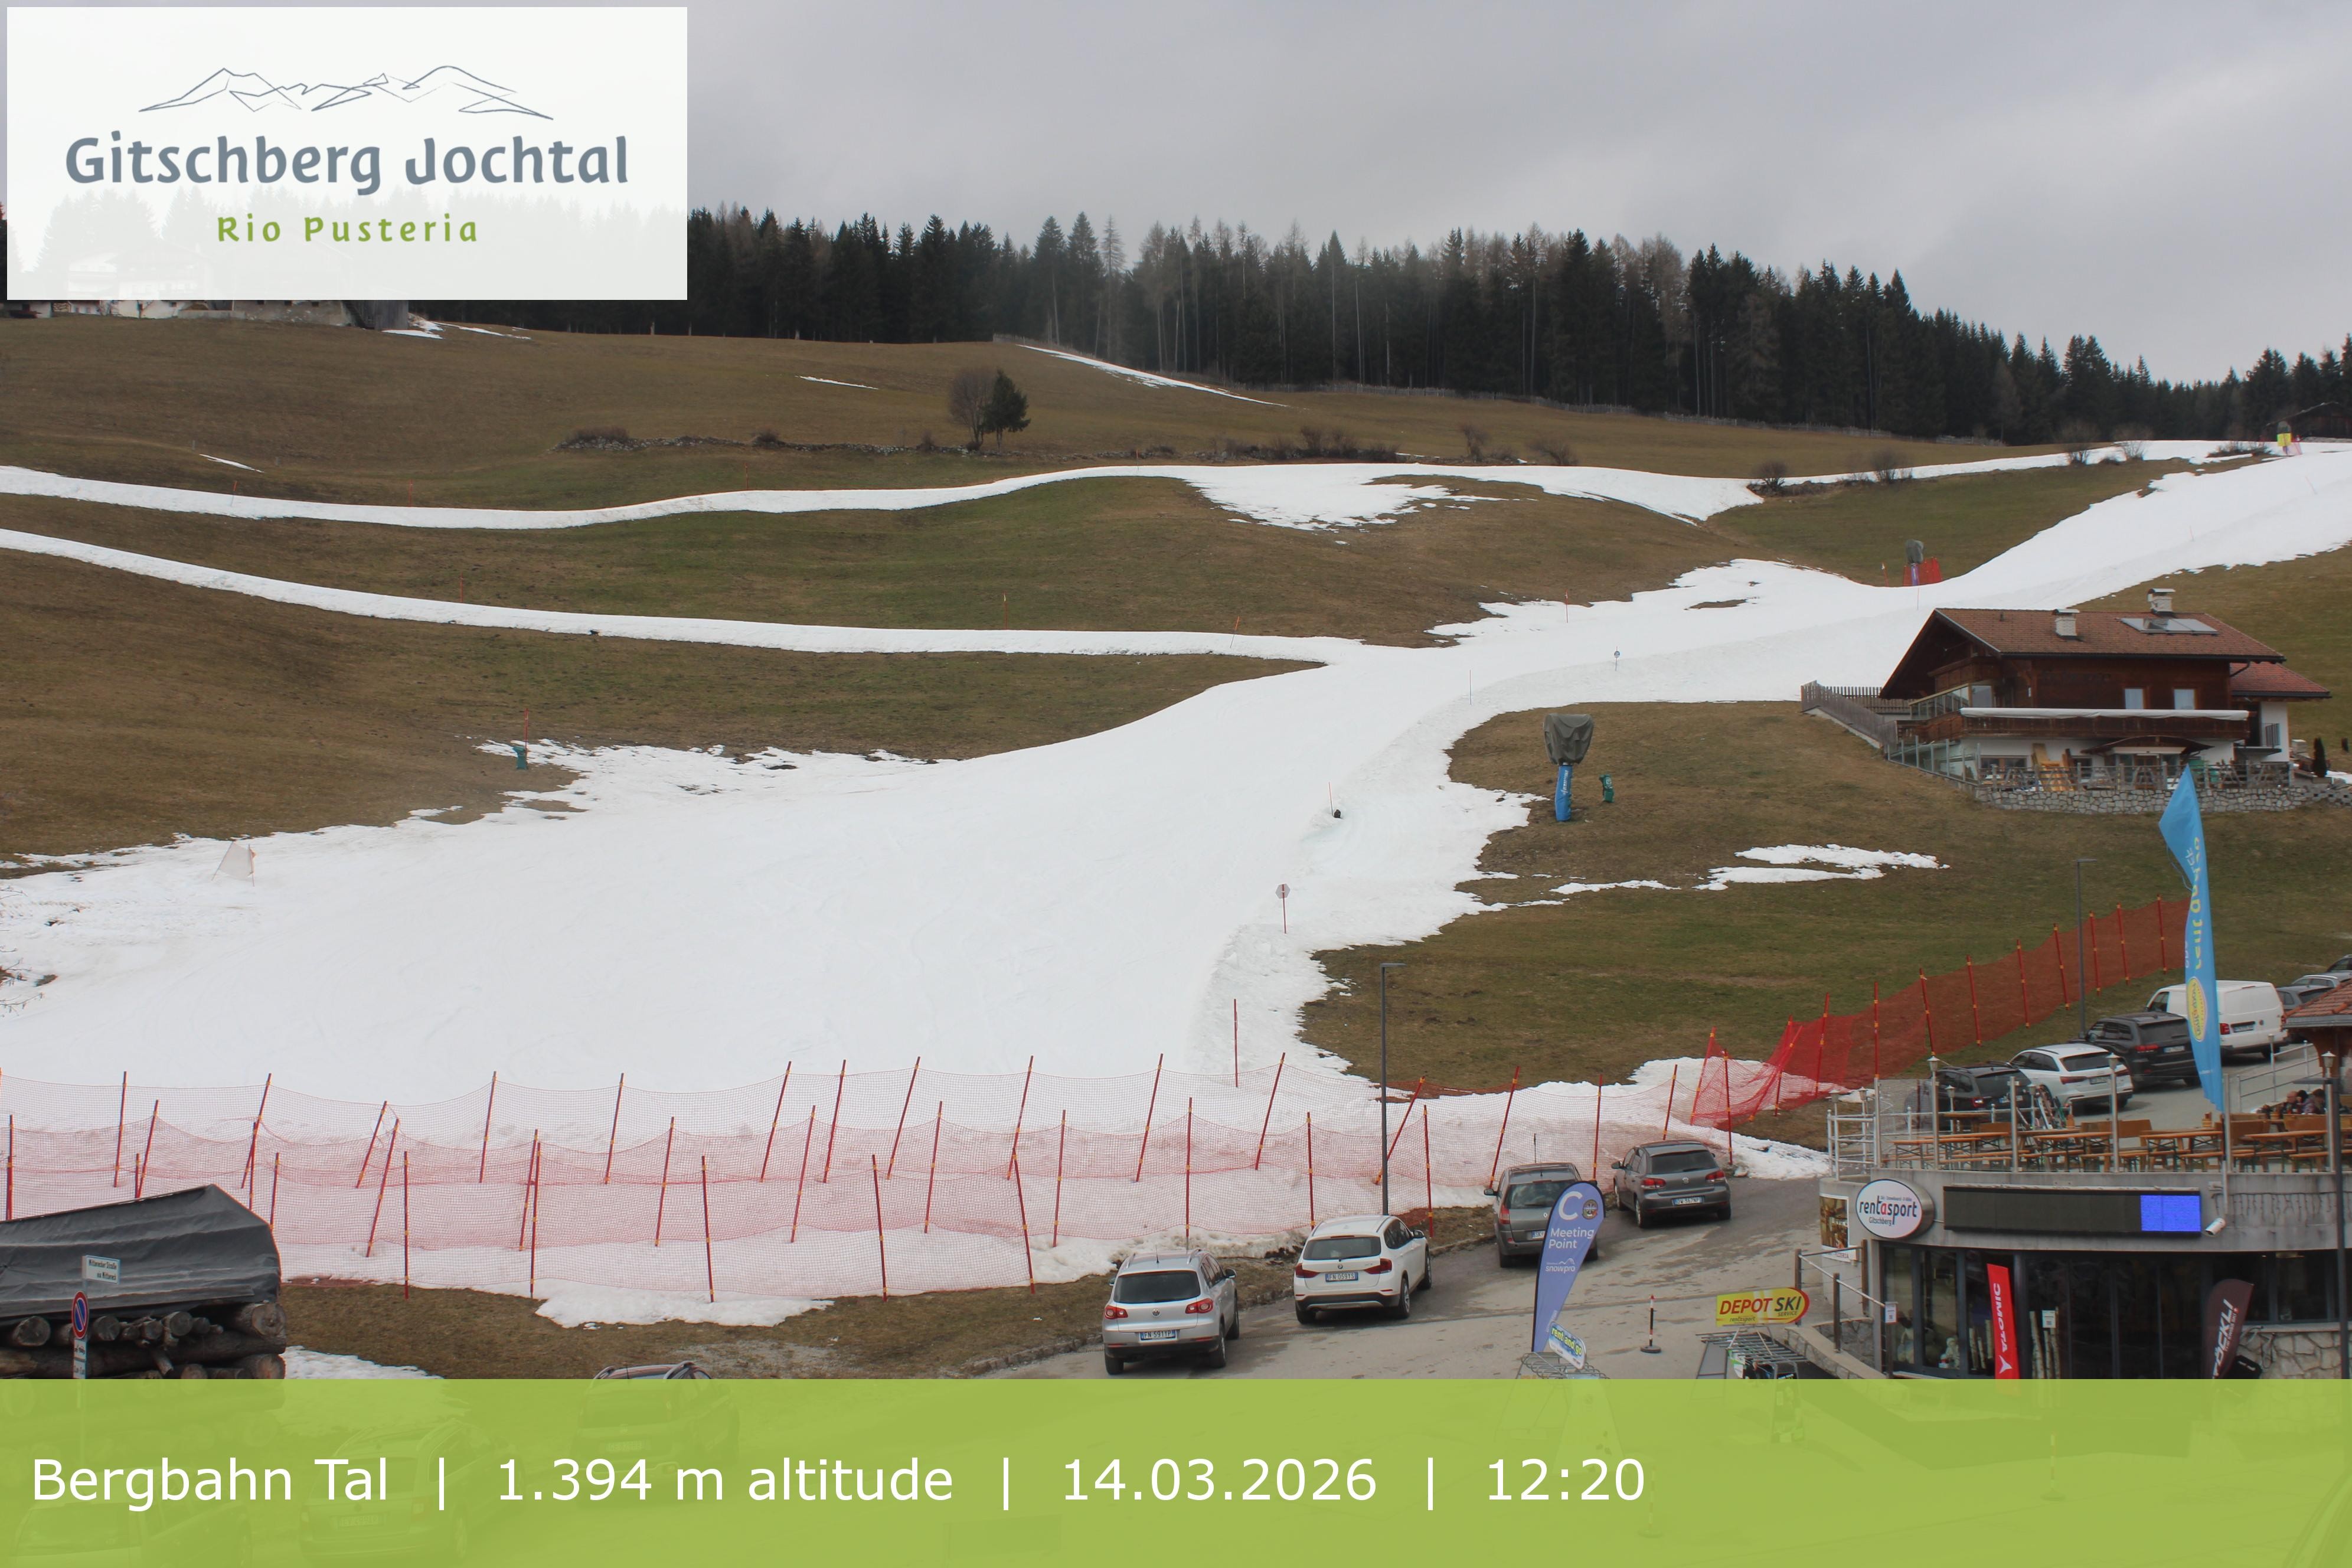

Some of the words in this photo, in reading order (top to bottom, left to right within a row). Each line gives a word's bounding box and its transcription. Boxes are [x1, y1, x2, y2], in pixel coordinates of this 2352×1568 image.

[1859, 1195, 1917, 1225] rentasport
[1868, 1217, 1892, 1226] Gitschberg
[1550, 1227, 1594, 1239] Meeting
[1549, 1238, 1577, 1249] Point
[1546, 1265, 1576, 1274] snowpro
[1719, 1298, 1773, 1315] DEPOT
[1774, 1296, 1802, 1312] SKI
[1551, 1327, 1564, 1341] rent
[1564, 1336, 1575, 1350] and
[1574, 1343, 1583, 1356] go
